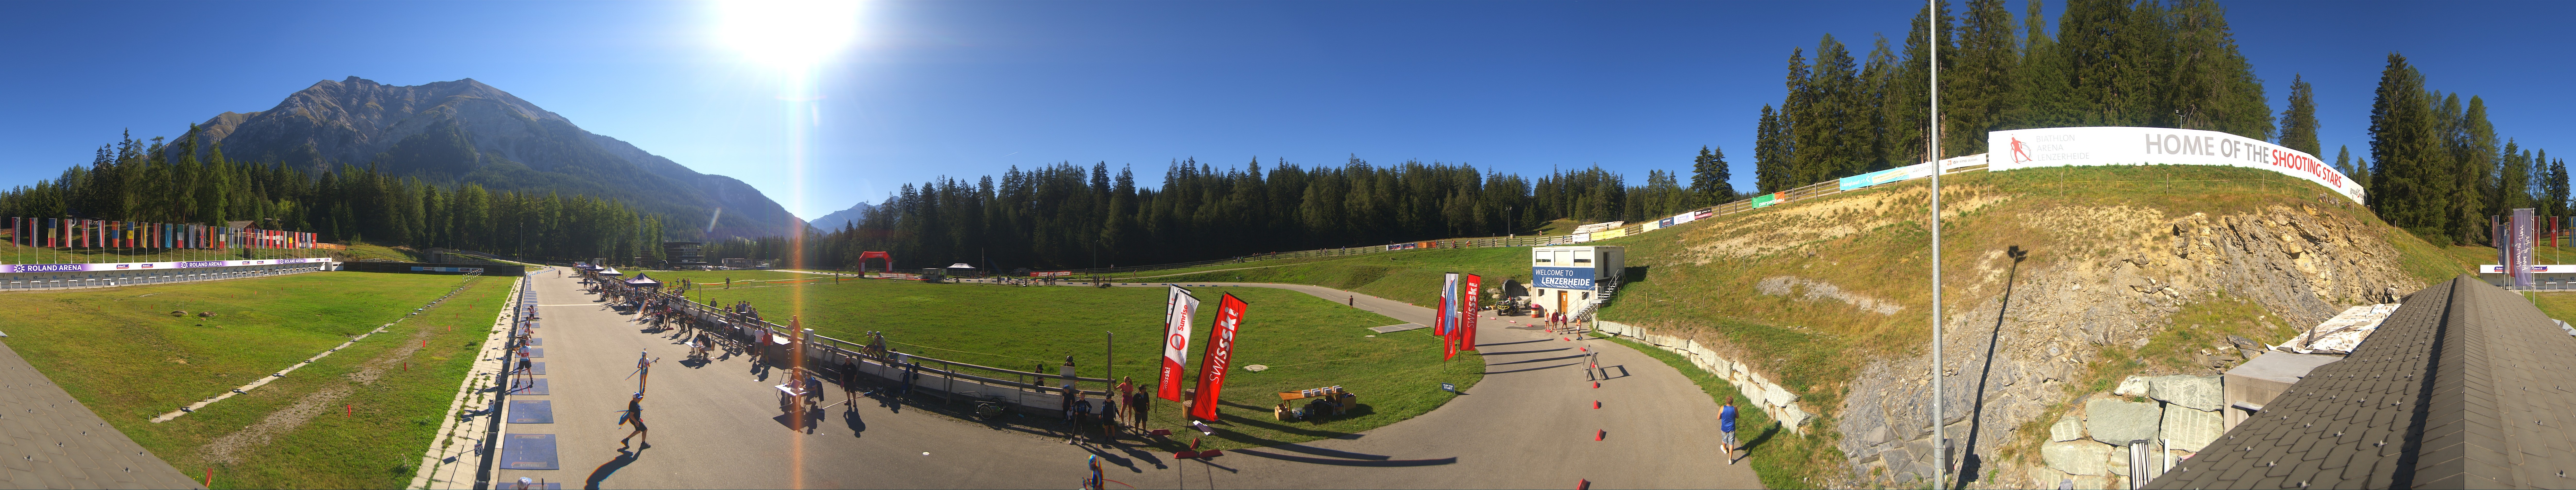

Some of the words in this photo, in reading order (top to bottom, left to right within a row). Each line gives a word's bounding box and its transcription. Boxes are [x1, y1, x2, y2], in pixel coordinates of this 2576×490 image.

[2038, 153, 2089, 161] LENZERHEIDE
[2146, 134, 2215, 156] HOME
[2221, 138, 2240, 158] OF
[2244, 143, 2269, 164] THE
[2273, 149, 2321, 177] SHOOTING
[2323, 167, 2341, 188] STARS
[1759, 198, 1785, 207] parpanbau
[1541, 277, 1590, 286] LENZERHEIDE
[1178, 305, 1188, 331] Sunrise
[1467, 283, 1478, 329] swissski
[1209, 307, 1239, 384] swissski
[1163, 366, 1171, 391] swissski
[475, 447, 482, 456] 30
